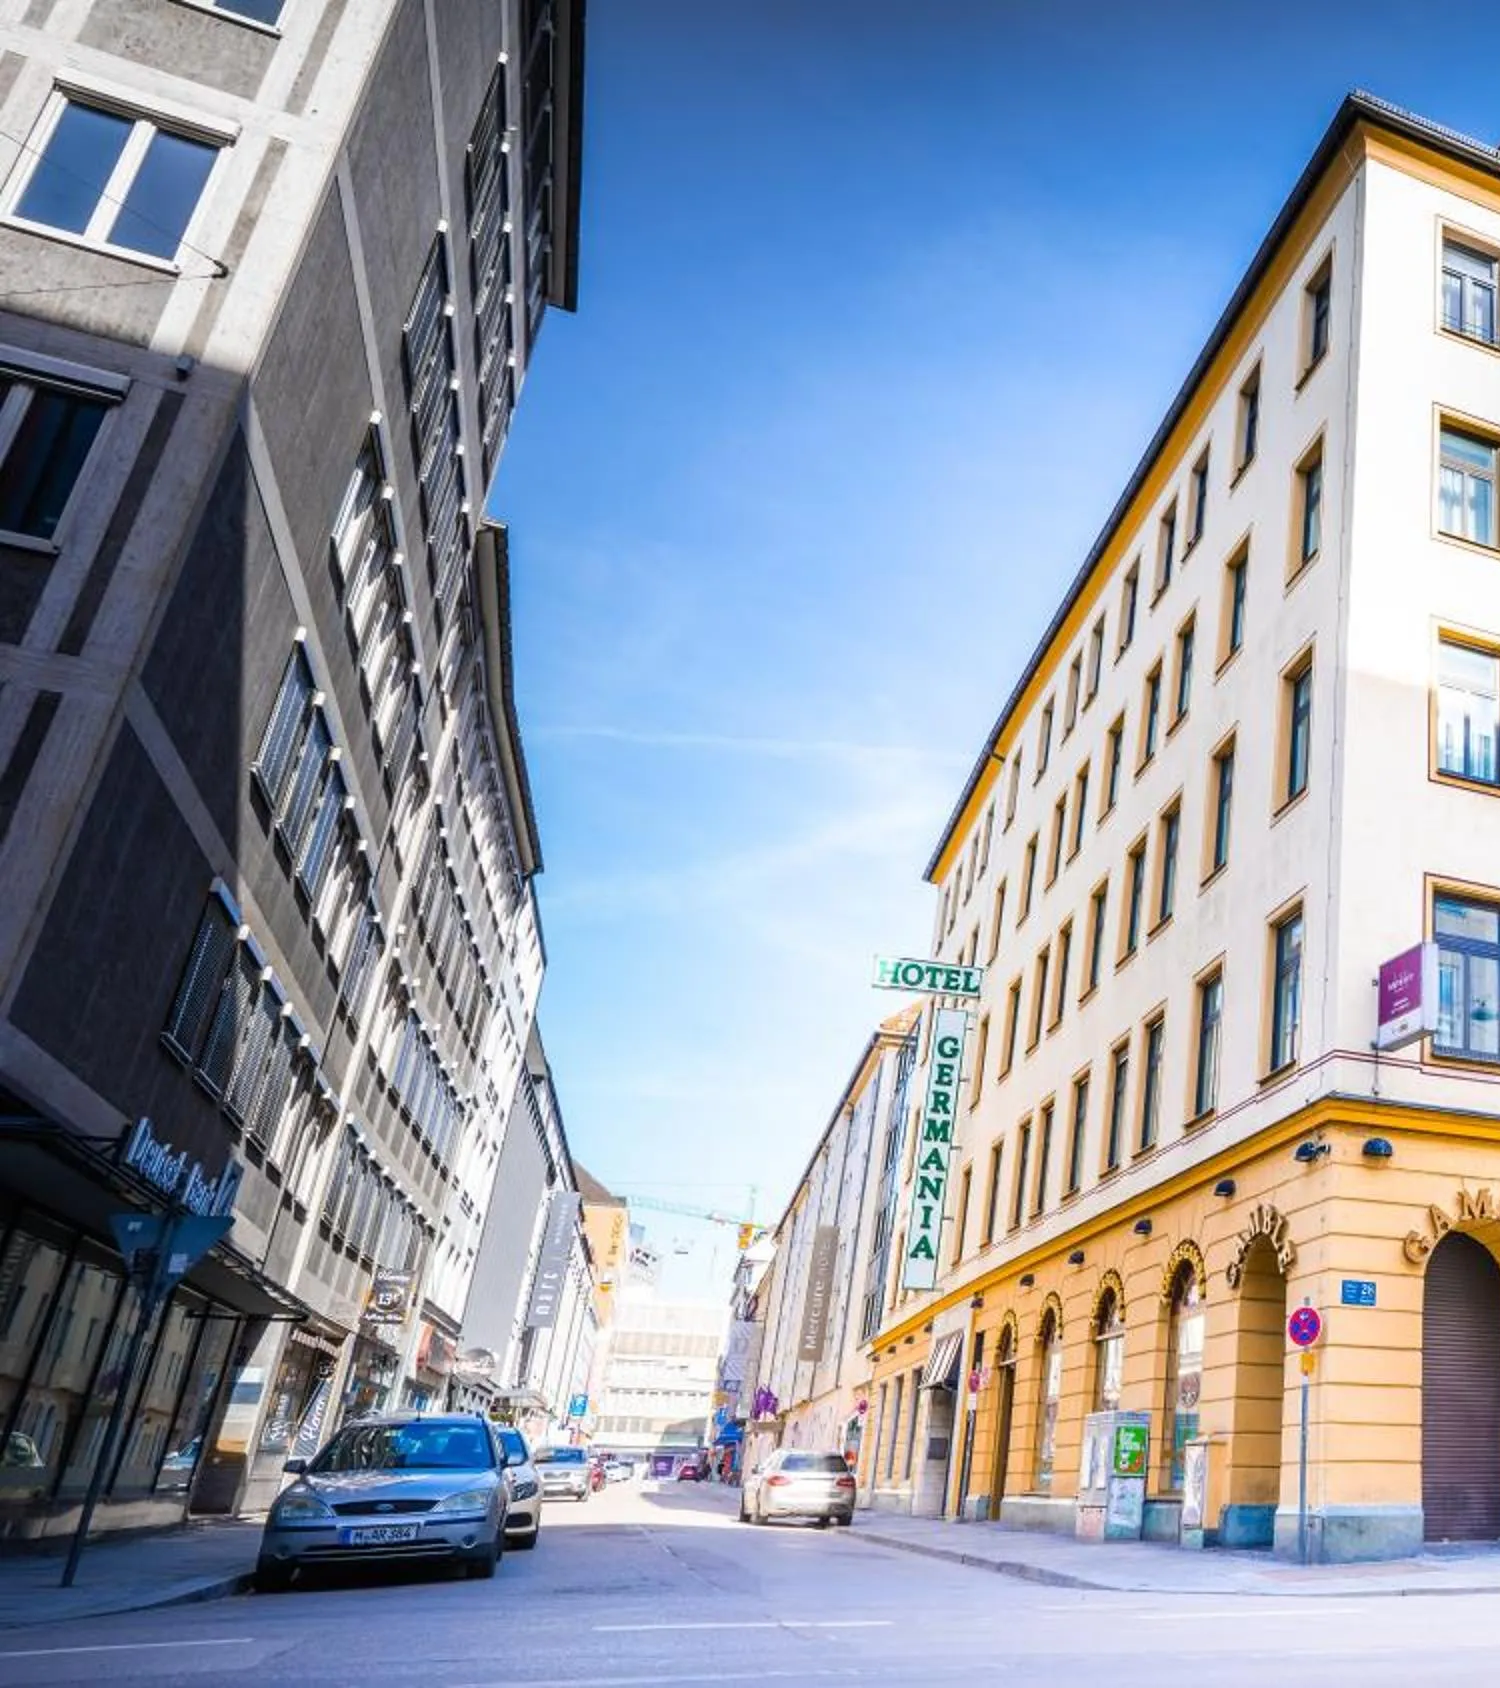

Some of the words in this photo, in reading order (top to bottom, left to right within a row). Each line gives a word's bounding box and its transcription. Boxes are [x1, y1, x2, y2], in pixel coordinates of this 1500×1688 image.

[877, 960, 980, 993] HOTEL
[909, 1036, 960, 1260] GERMANIA
[804, 1281, 825, 1349] Mercure
